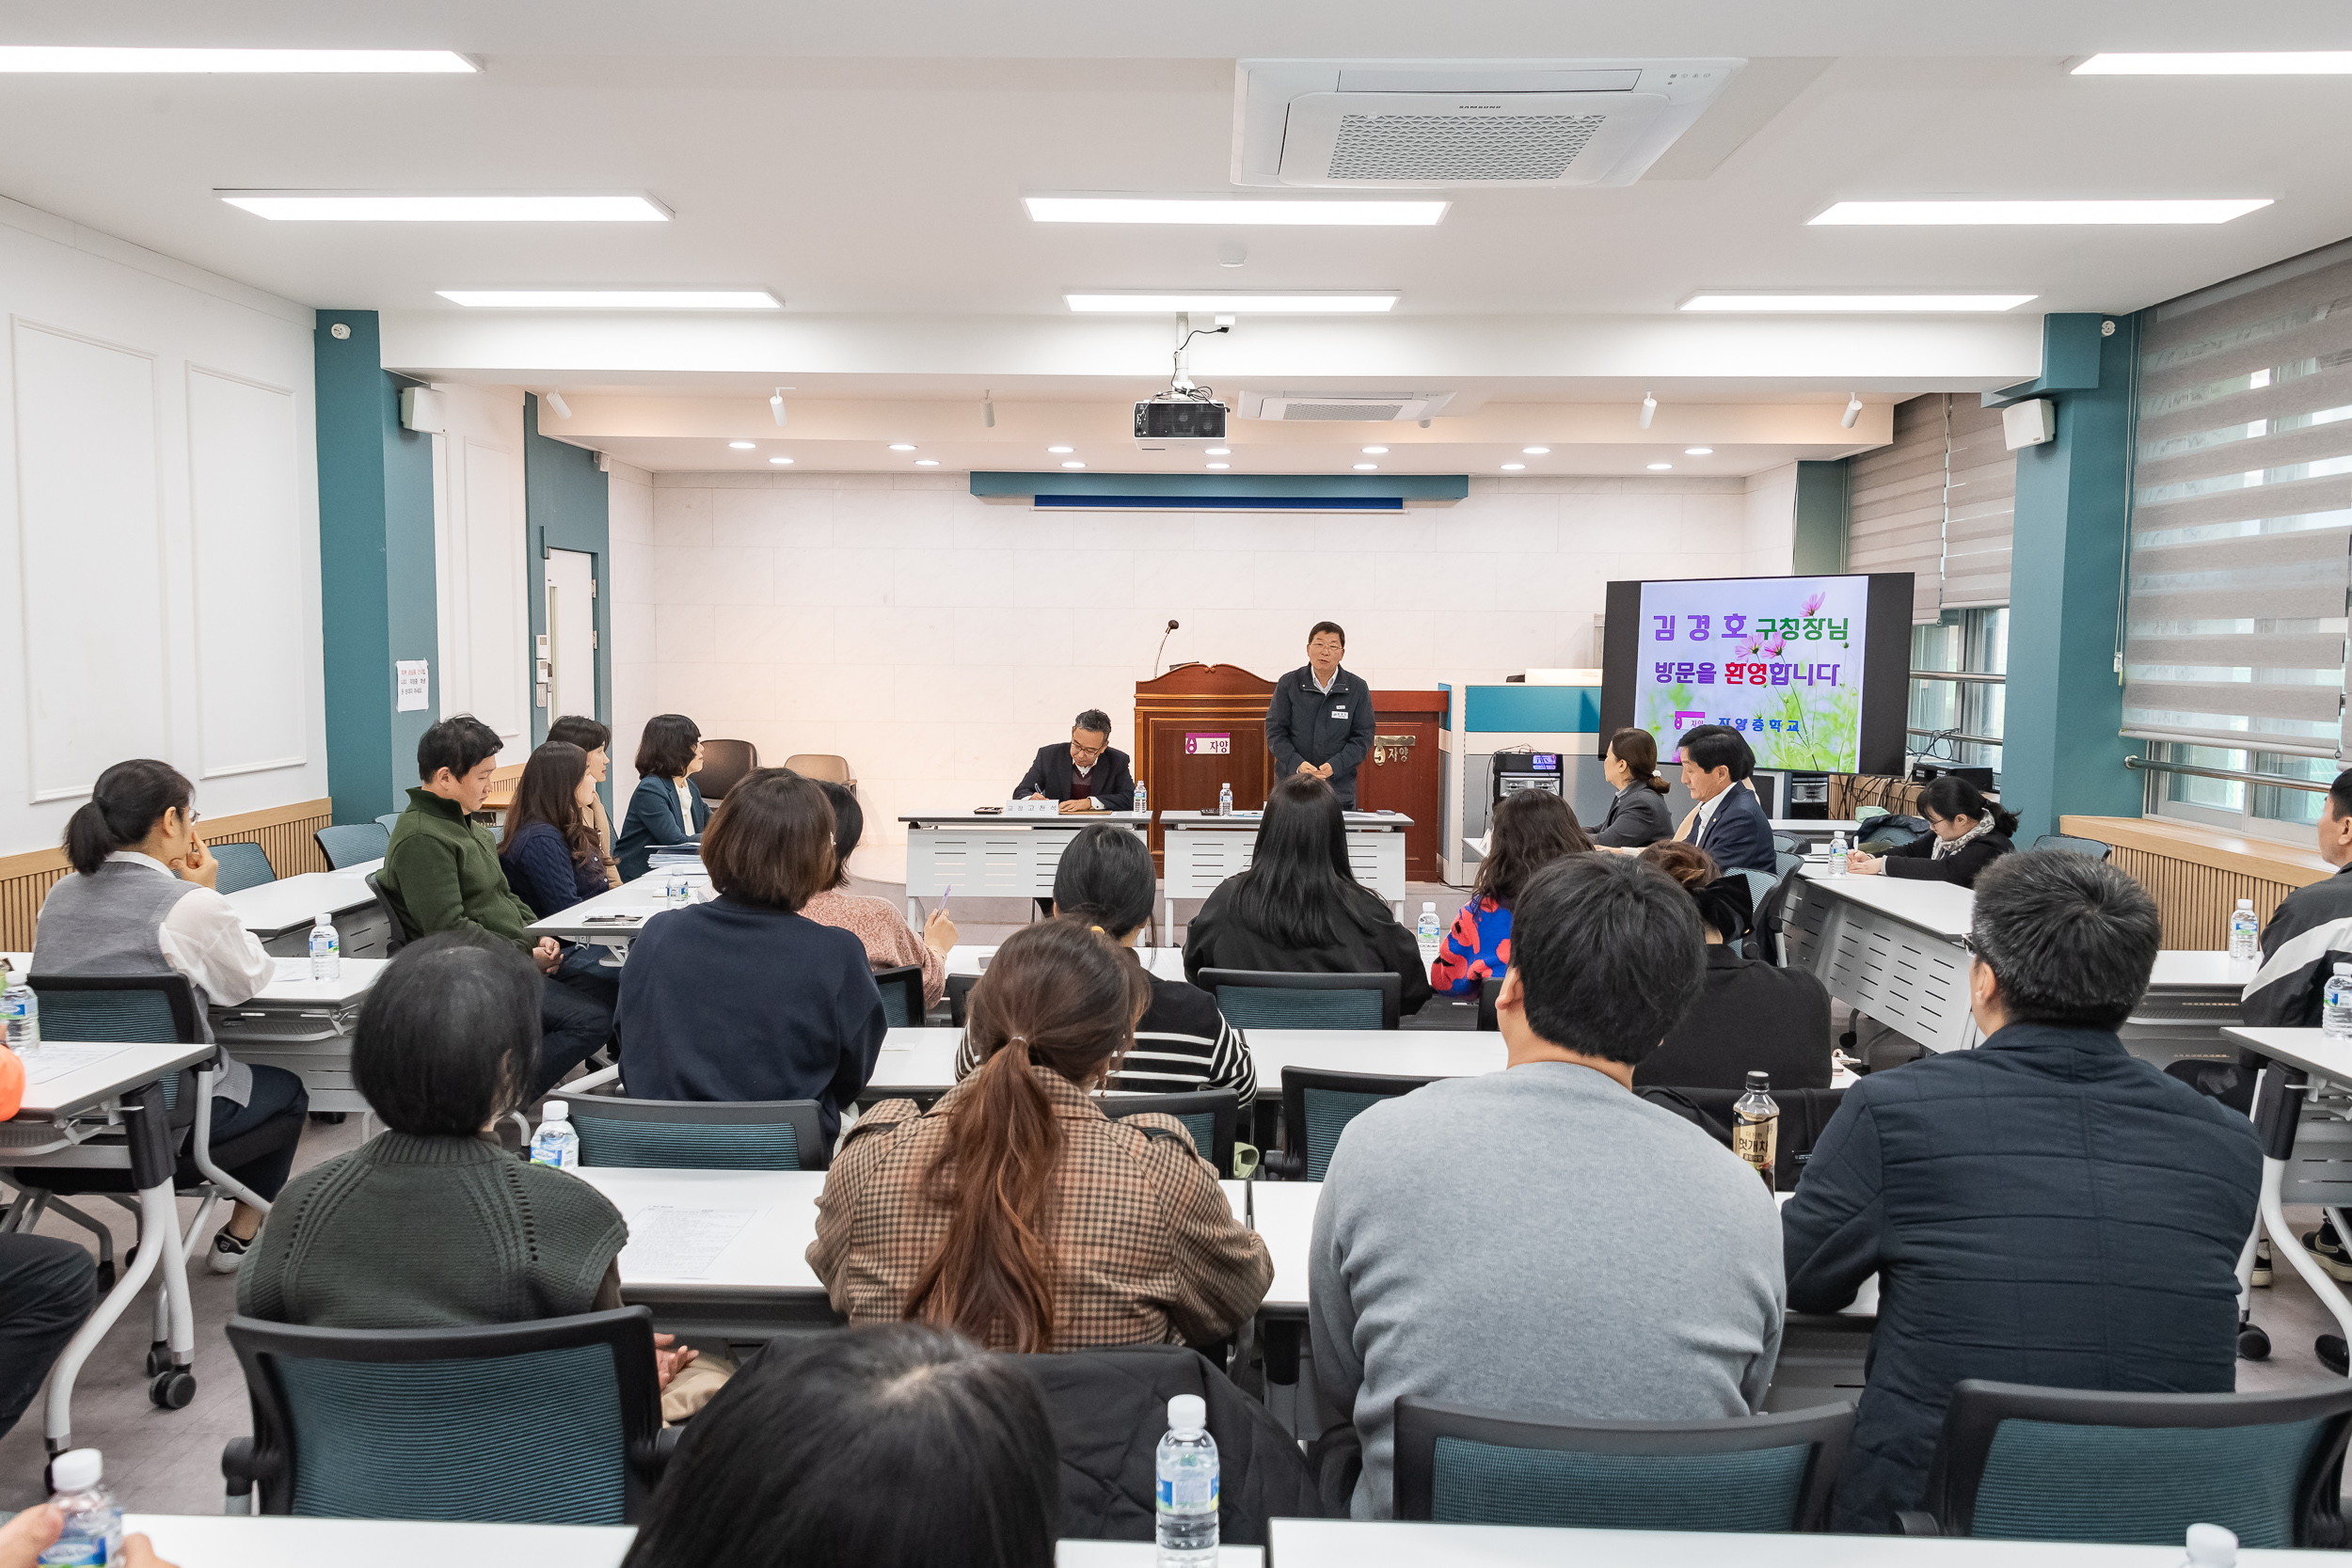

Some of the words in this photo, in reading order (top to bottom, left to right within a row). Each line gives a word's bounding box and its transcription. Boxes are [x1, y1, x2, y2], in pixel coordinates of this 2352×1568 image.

[1756, 617, 1849, 641] 구청장님
[1654, 661, 1717, 684] 방문을
[1724, 662, 1841, 686] 환영합니다
[1210, 740, 1229, 753] 자양
[1388, 747, 1409, 763] 자양
